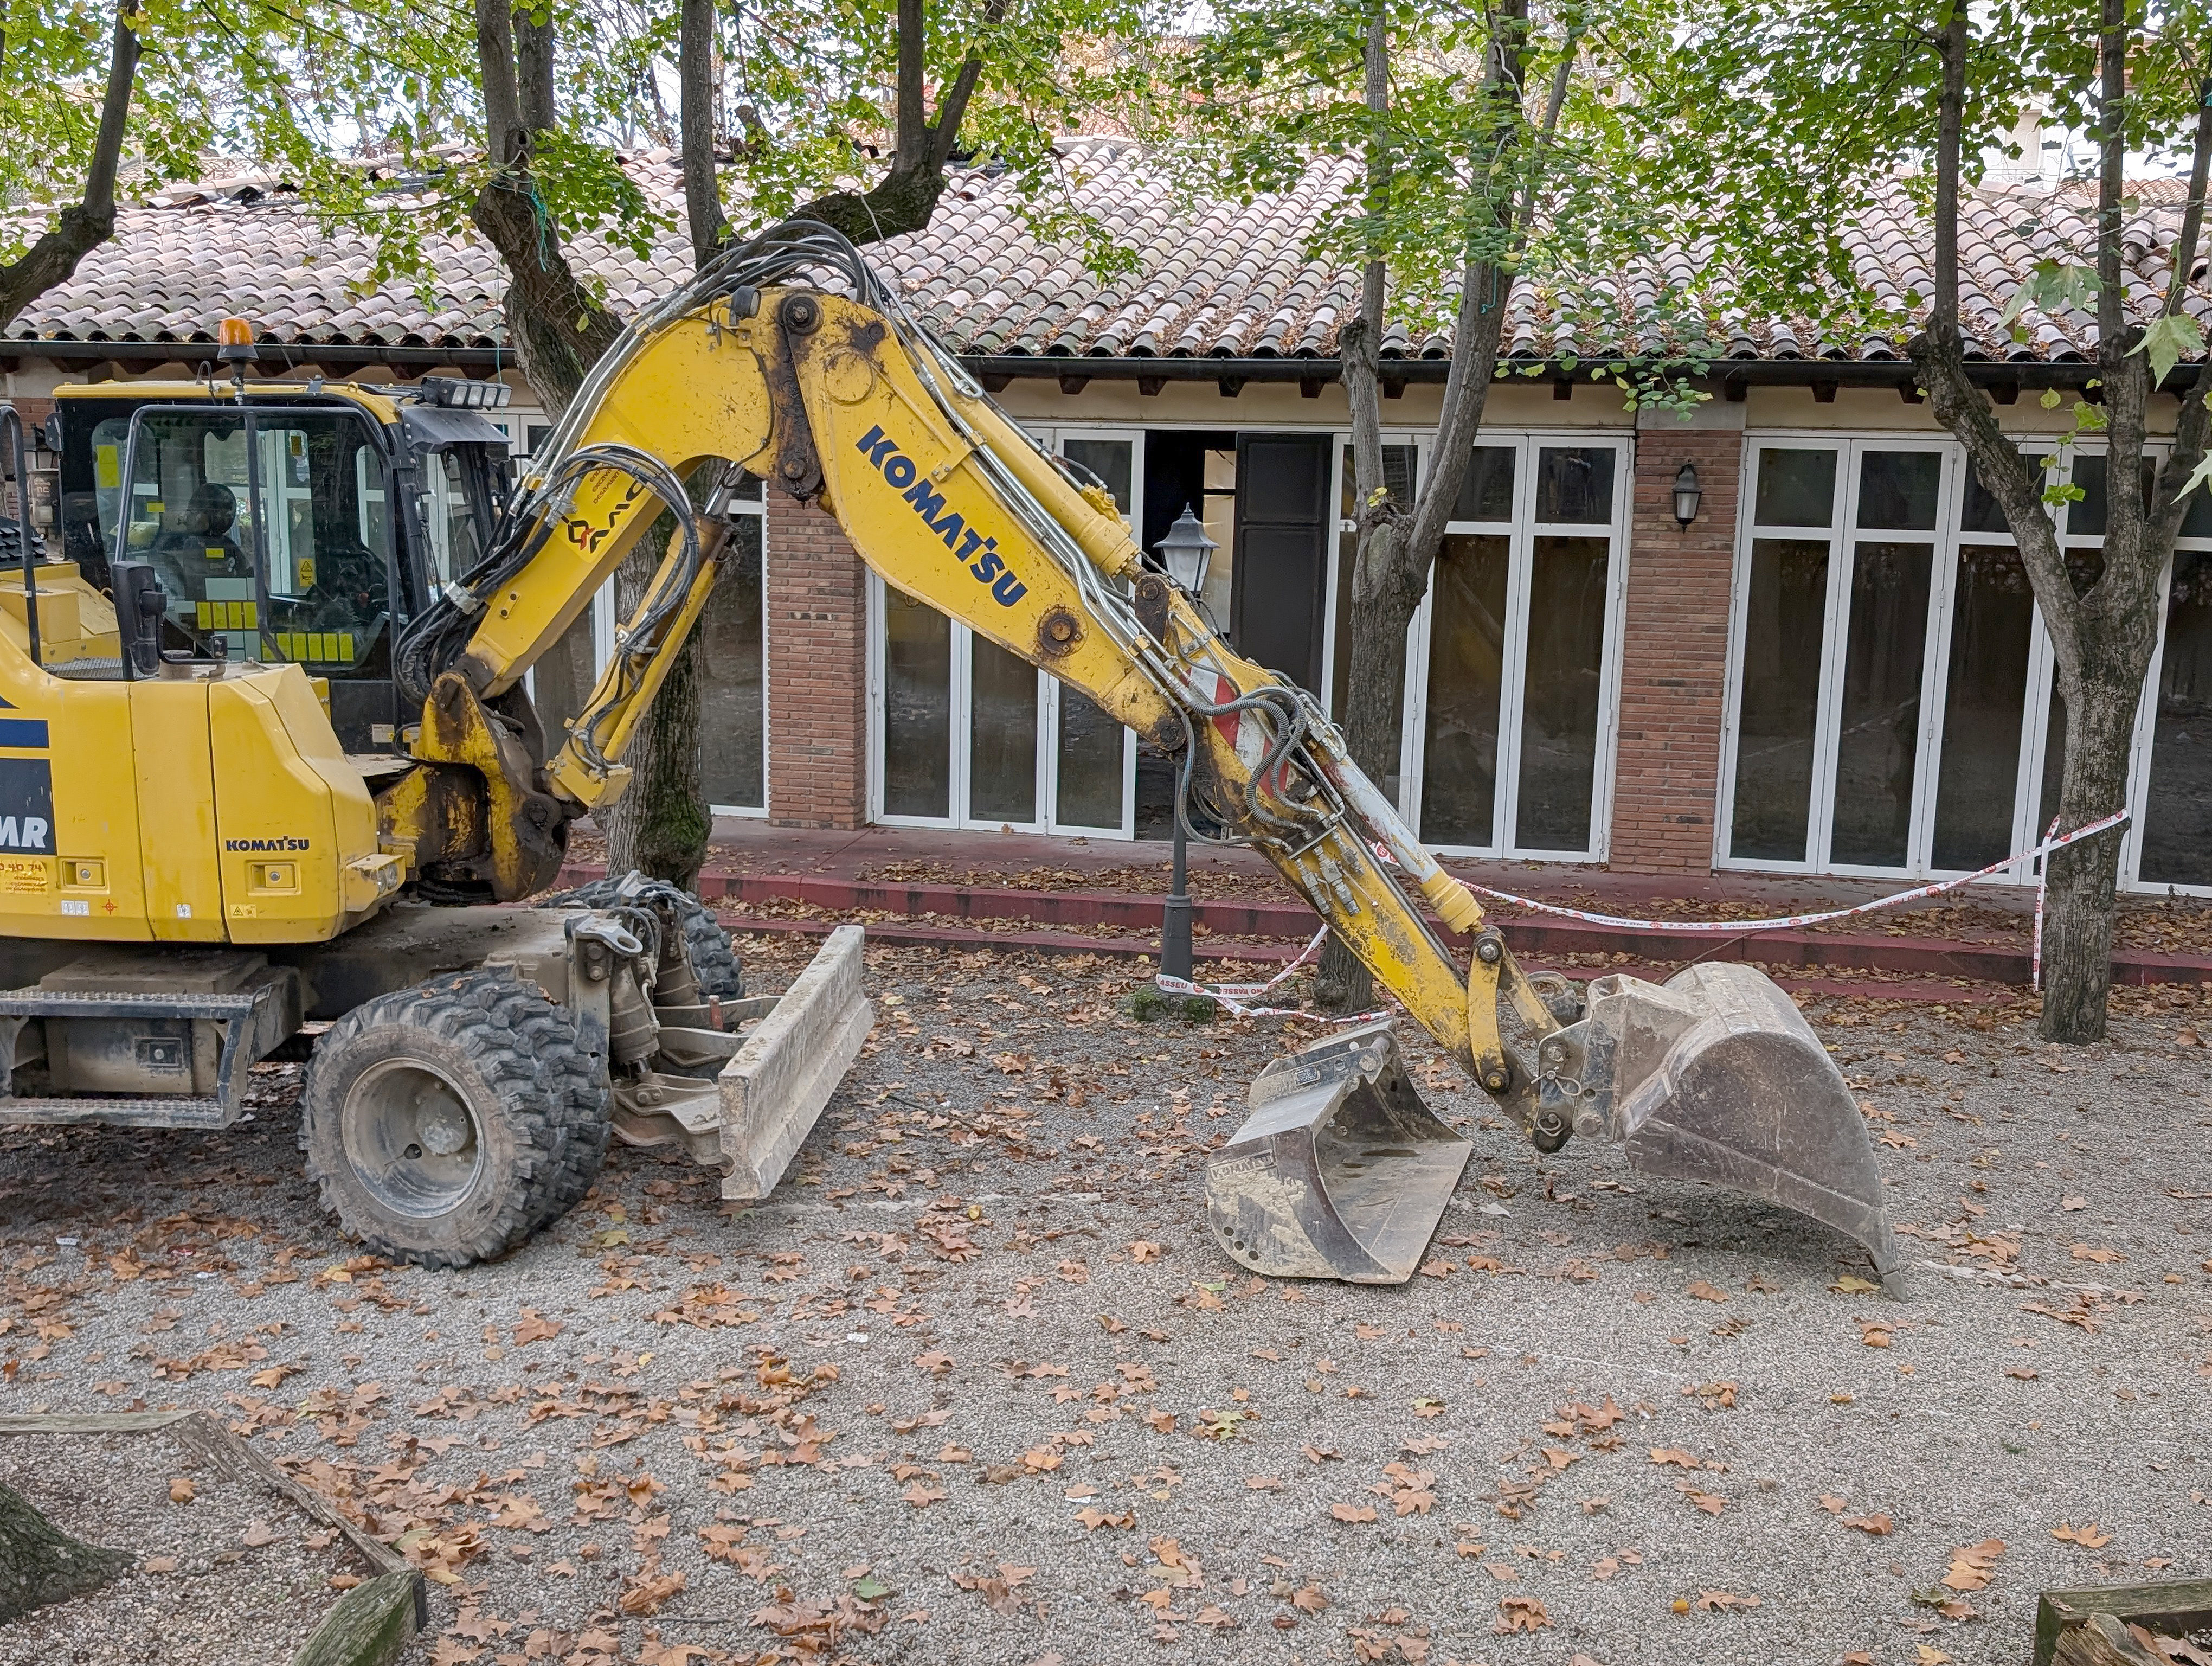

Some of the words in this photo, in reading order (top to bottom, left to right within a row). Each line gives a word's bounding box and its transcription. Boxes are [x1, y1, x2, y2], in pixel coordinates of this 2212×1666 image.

[855, 424, 1028, 607] KOMATSU
[226, 836, 310, 851] KOMATSU
[1159, 977, 1188, 990] ASSEU
